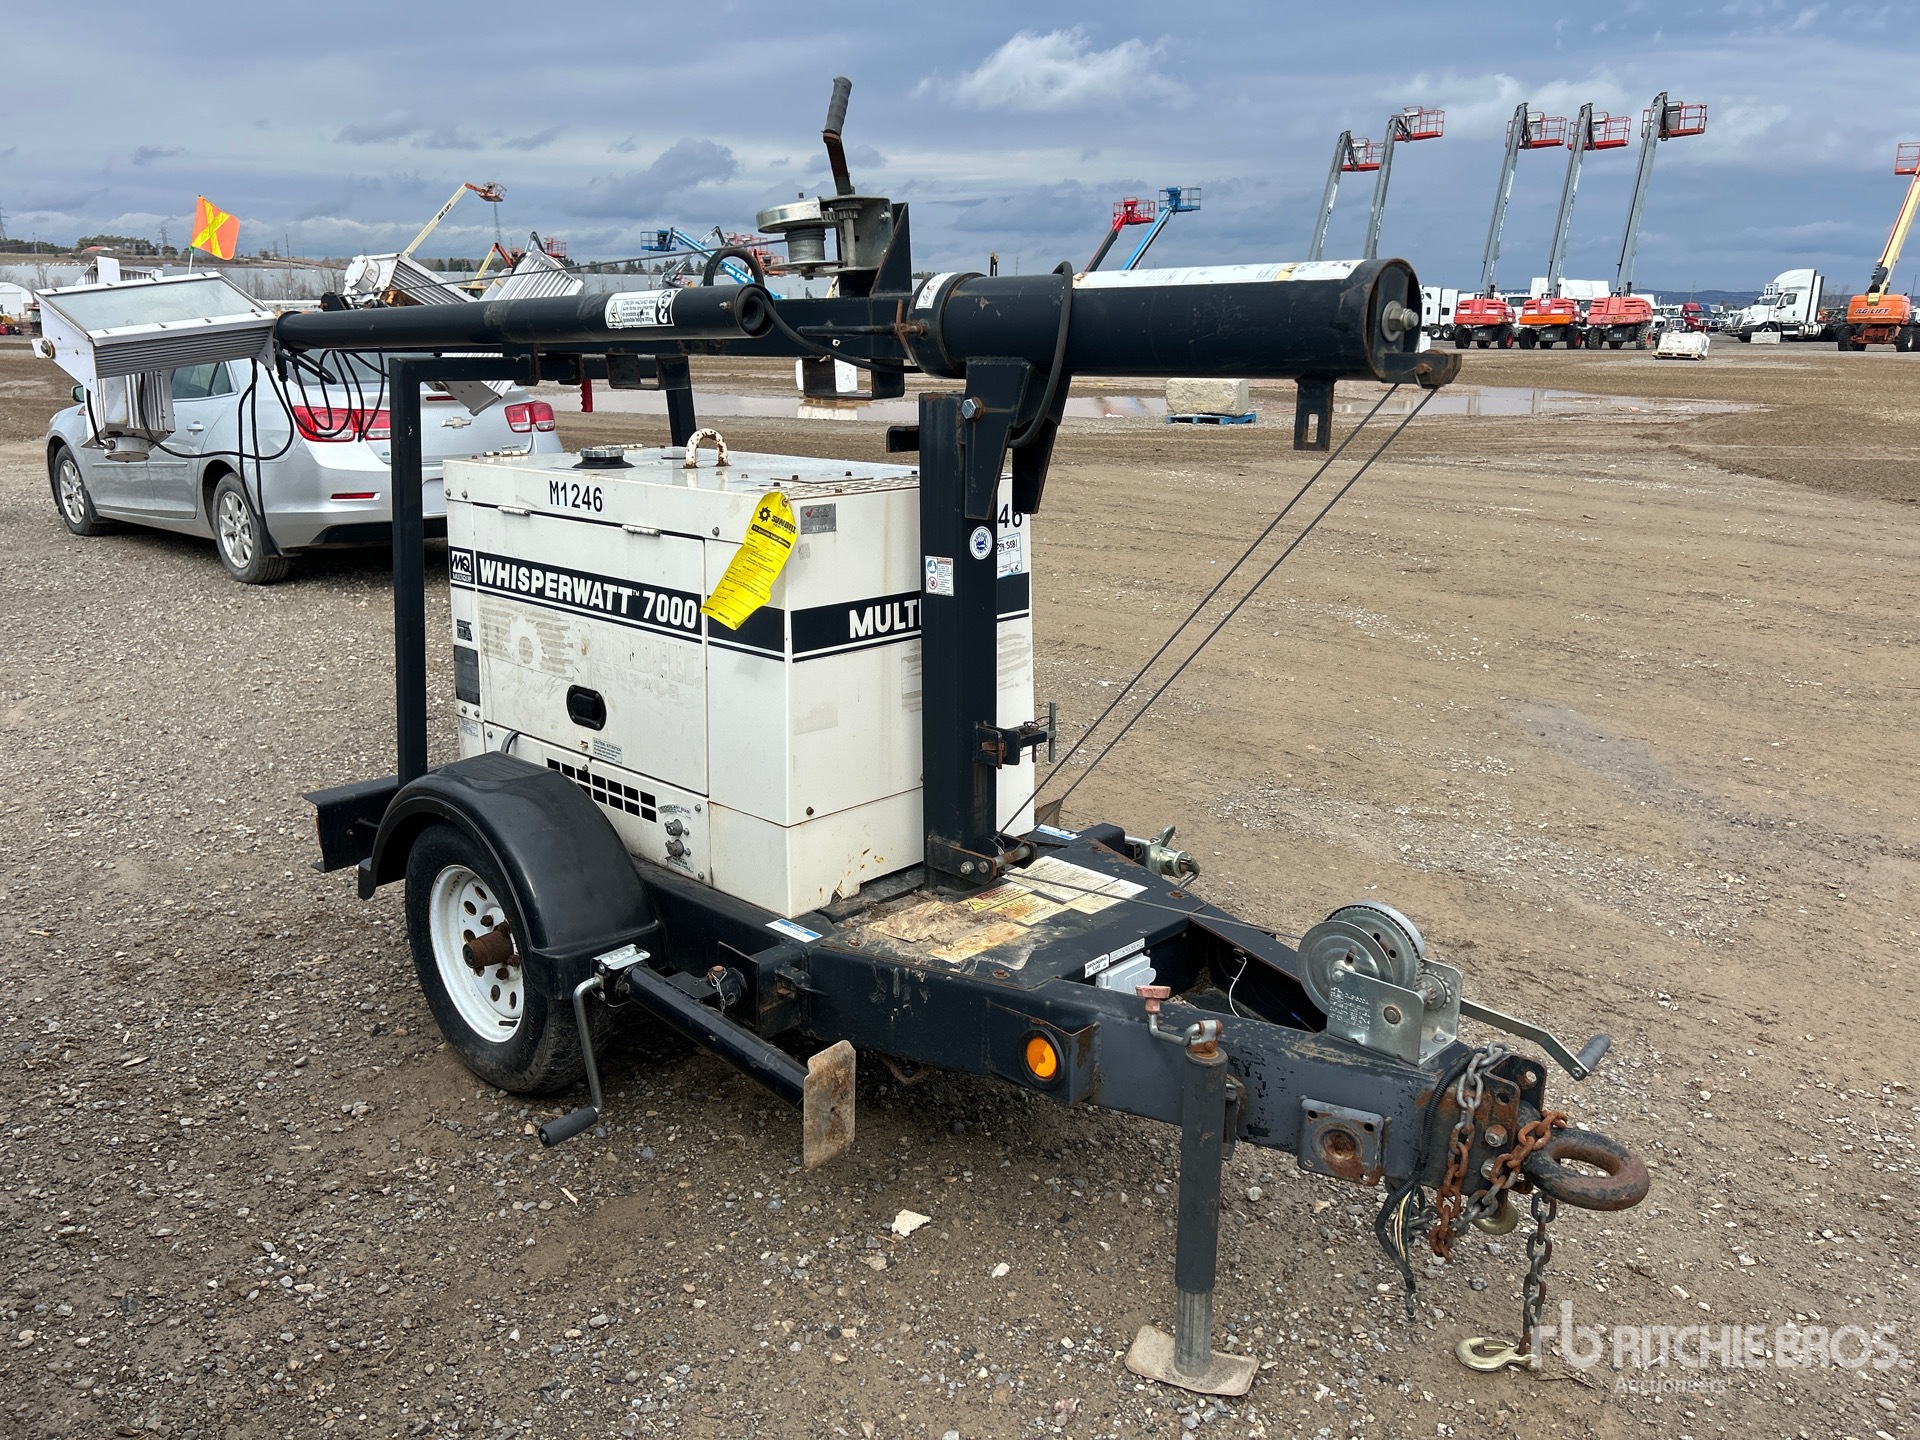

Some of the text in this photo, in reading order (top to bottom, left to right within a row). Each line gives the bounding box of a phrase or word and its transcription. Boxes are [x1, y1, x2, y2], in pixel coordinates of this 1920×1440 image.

[1765, 288, 1774, 296] 11
[549, 480, 603, 512] M1246
[642, 590, 698, 629] 7000
